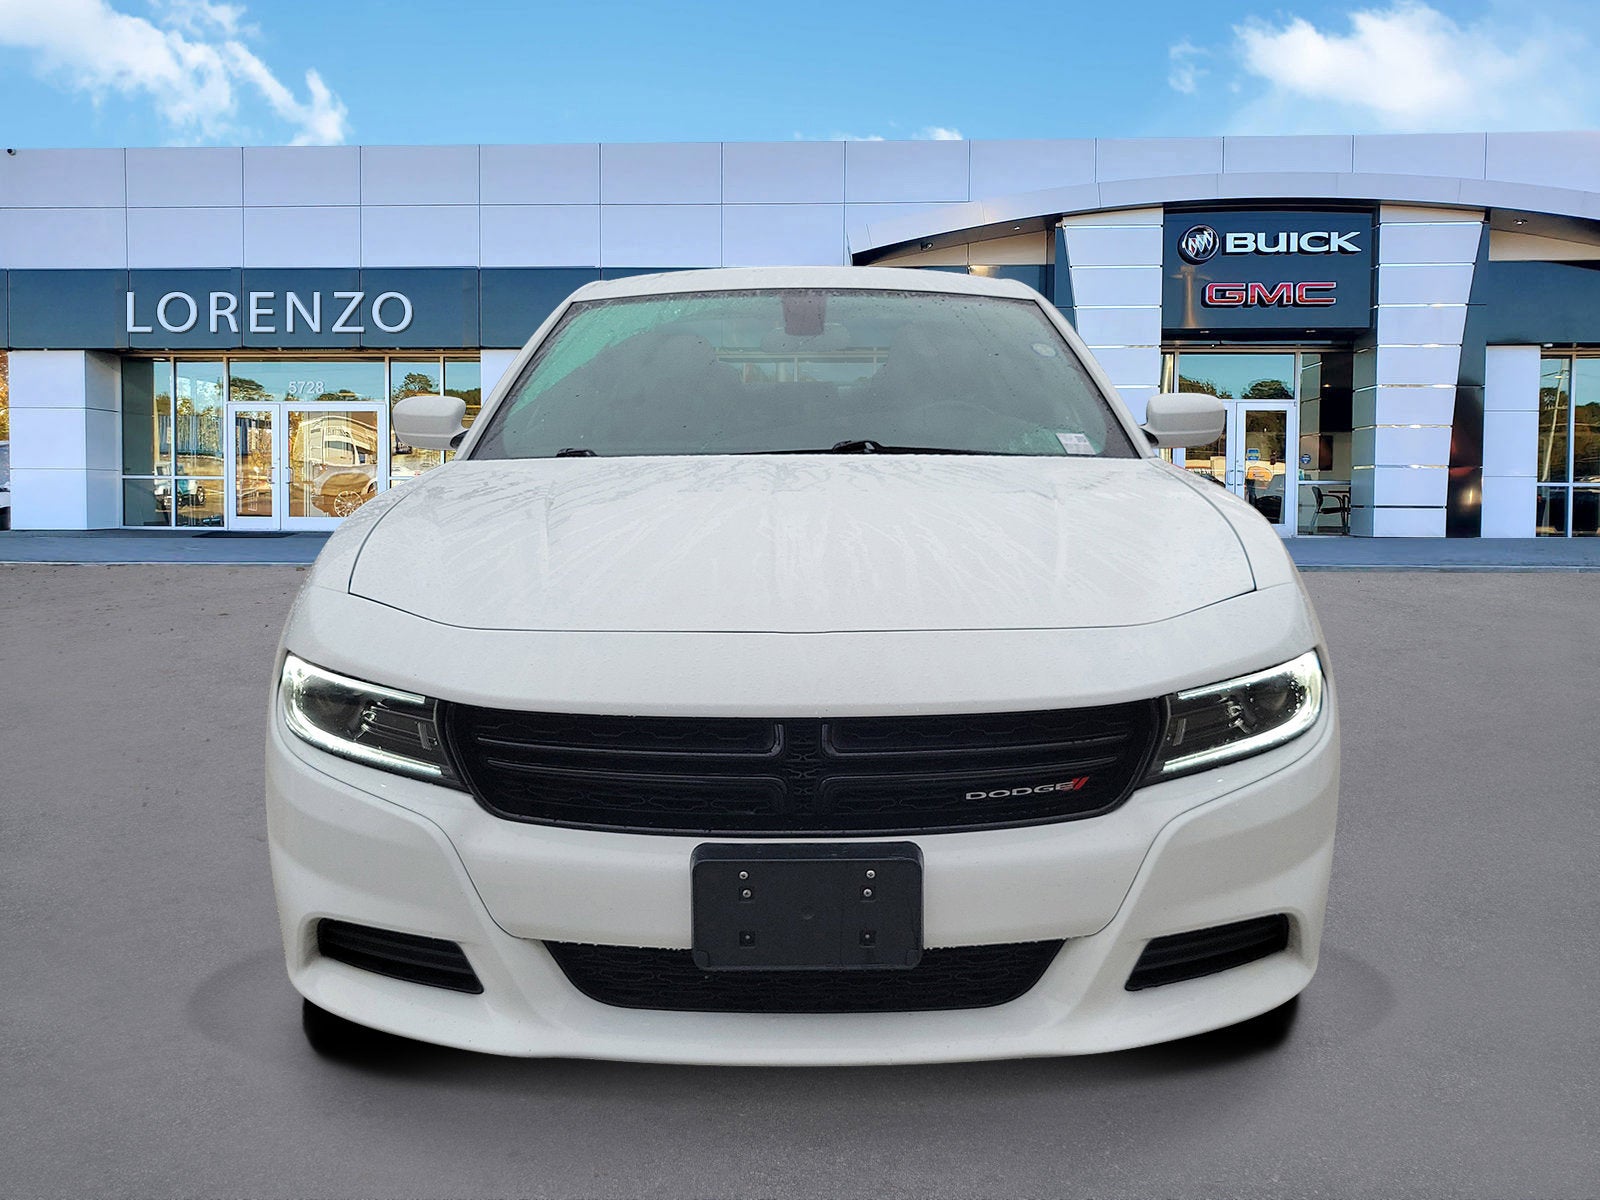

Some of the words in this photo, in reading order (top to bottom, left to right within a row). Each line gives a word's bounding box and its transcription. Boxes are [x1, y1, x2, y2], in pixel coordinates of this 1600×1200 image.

[1225, 231, 1362, 253] BUICK
[1205, 281, 1337, 305] GMC
[126, 291, 413, 333] LORENZO
[288, 380, 325, 394] 5728
[965, 780, 1075, 800] DODGE
